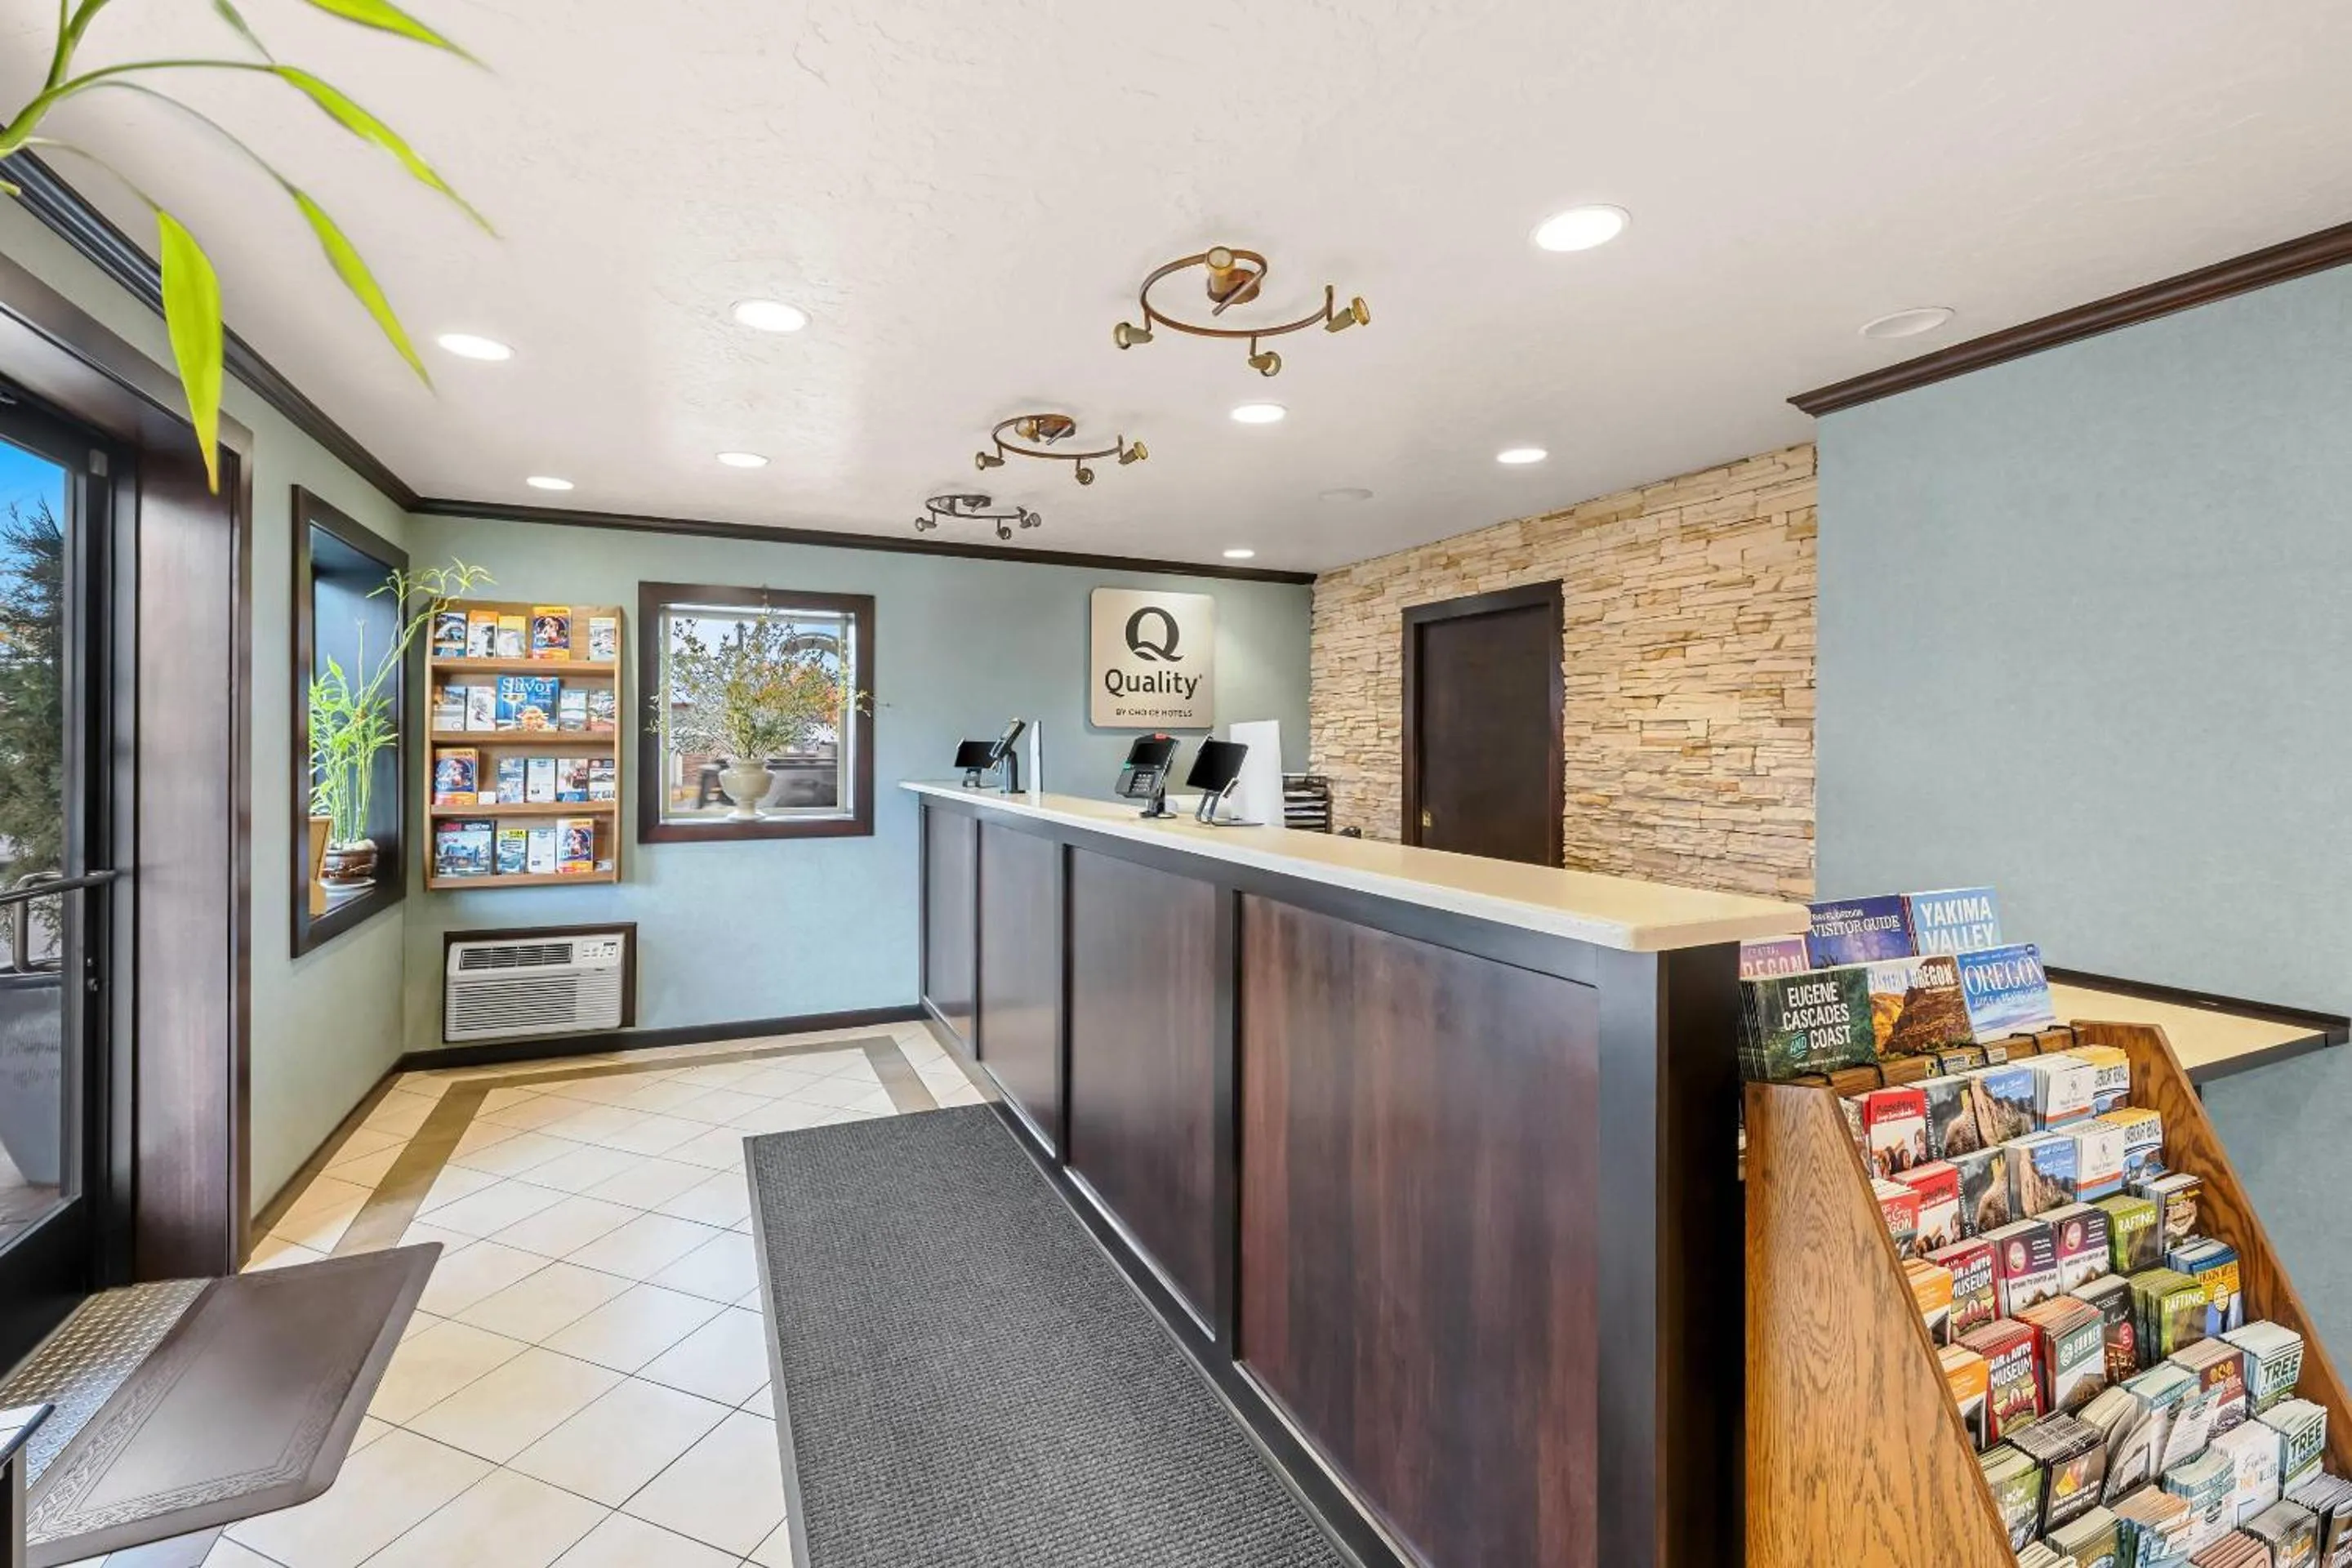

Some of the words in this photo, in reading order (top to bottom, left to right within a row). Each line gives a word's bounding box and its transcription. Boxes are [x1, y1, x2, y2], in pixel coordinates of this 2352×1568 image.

[1125, 606, 1184, 662] Q
[1105, 669, 1199, 700] Quality
[1128, 708, 1160, 716] CHOICE
[1161, 709, 1193, 718] HOTELS
[1920, 895, 1993, 928] YAKIMA
[1811, 920, 1863, 938] VISITOR
[1864, 915, 1901, 932] GUIDE
[1923, 922, 1993, 956] VALLEY
[1910, 964, 1955, 989] OREGON
[1964, 957, 2045, 996] OREGON
[1787, 982, 1839, 1008] EUGENE
[1783, 1003, 1850, 1031] CASCADES
[1790, 1036, 1807, 1054] AND
[1810, 1024, 1851, 1050] COAST
[2118, 1210, 2156, 1232] RAFTING
[2165, 1291, 2204, 1313] RAFTING
[1990, 1354, 2034, 1390] MUSEUM
[2264, 1352, 2301, 1385] TREE
[2291, 1418, 2323, 1460] TREE
